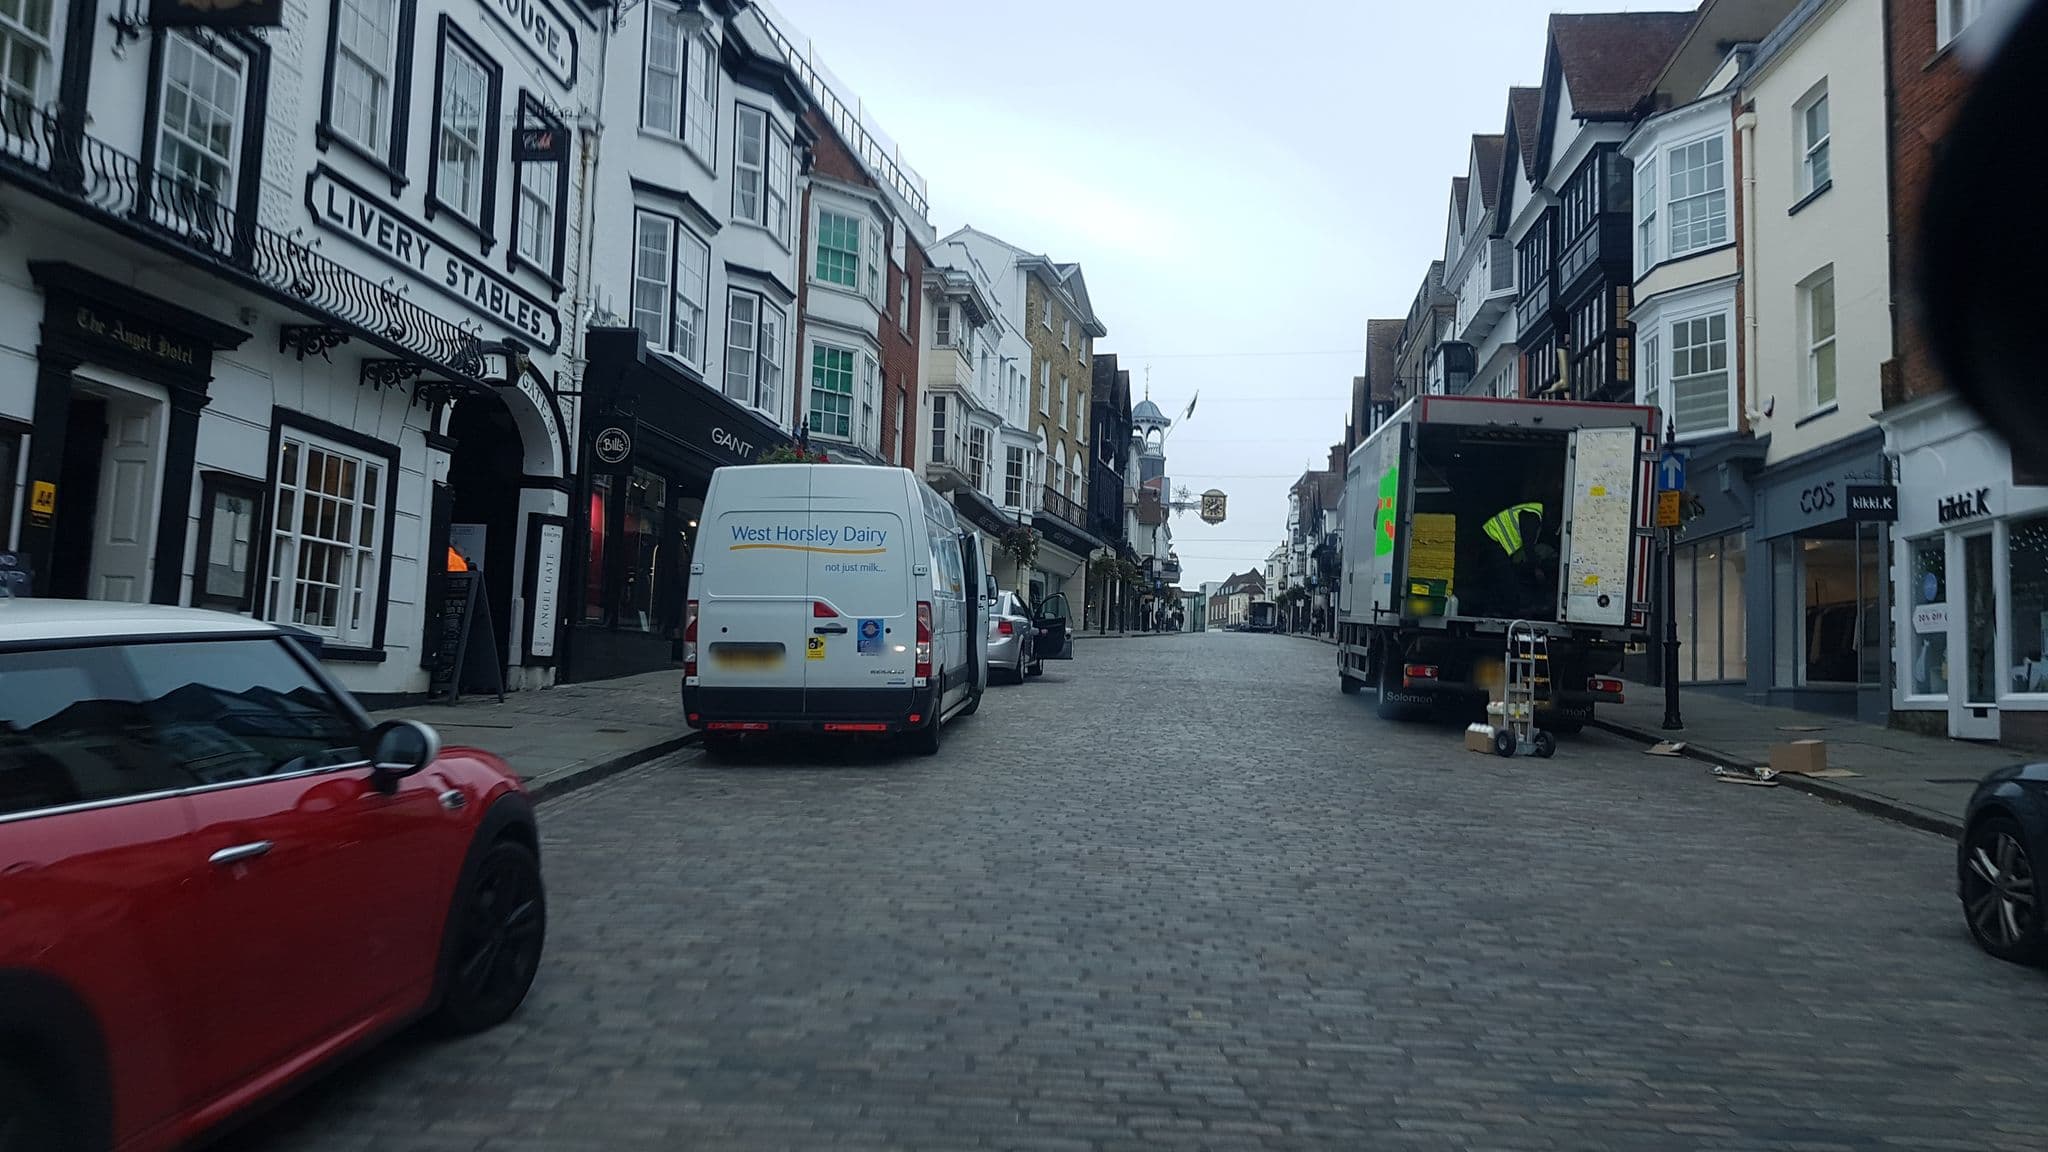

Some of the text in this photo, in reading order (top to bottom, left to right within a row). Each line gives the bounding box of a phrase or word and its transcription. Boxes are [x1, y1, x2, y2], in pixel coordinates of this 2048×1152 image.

[327, 183, 546, 340] LIVERY STABLES.
[78, 306, 193, 365] The Angel Hotel
[602, 437, 624, 451] Bill's
[712, 427, 753, 457] GANT
[1800, 482, 1835, 514] COS
[1852, 497, 1893, 511] kikki.K
[1938, 487, 1991, 523] kikki.K
[732, 524, 887, 546] West Horsley Dairy
[825, 563, 887, 575] not just milk...
